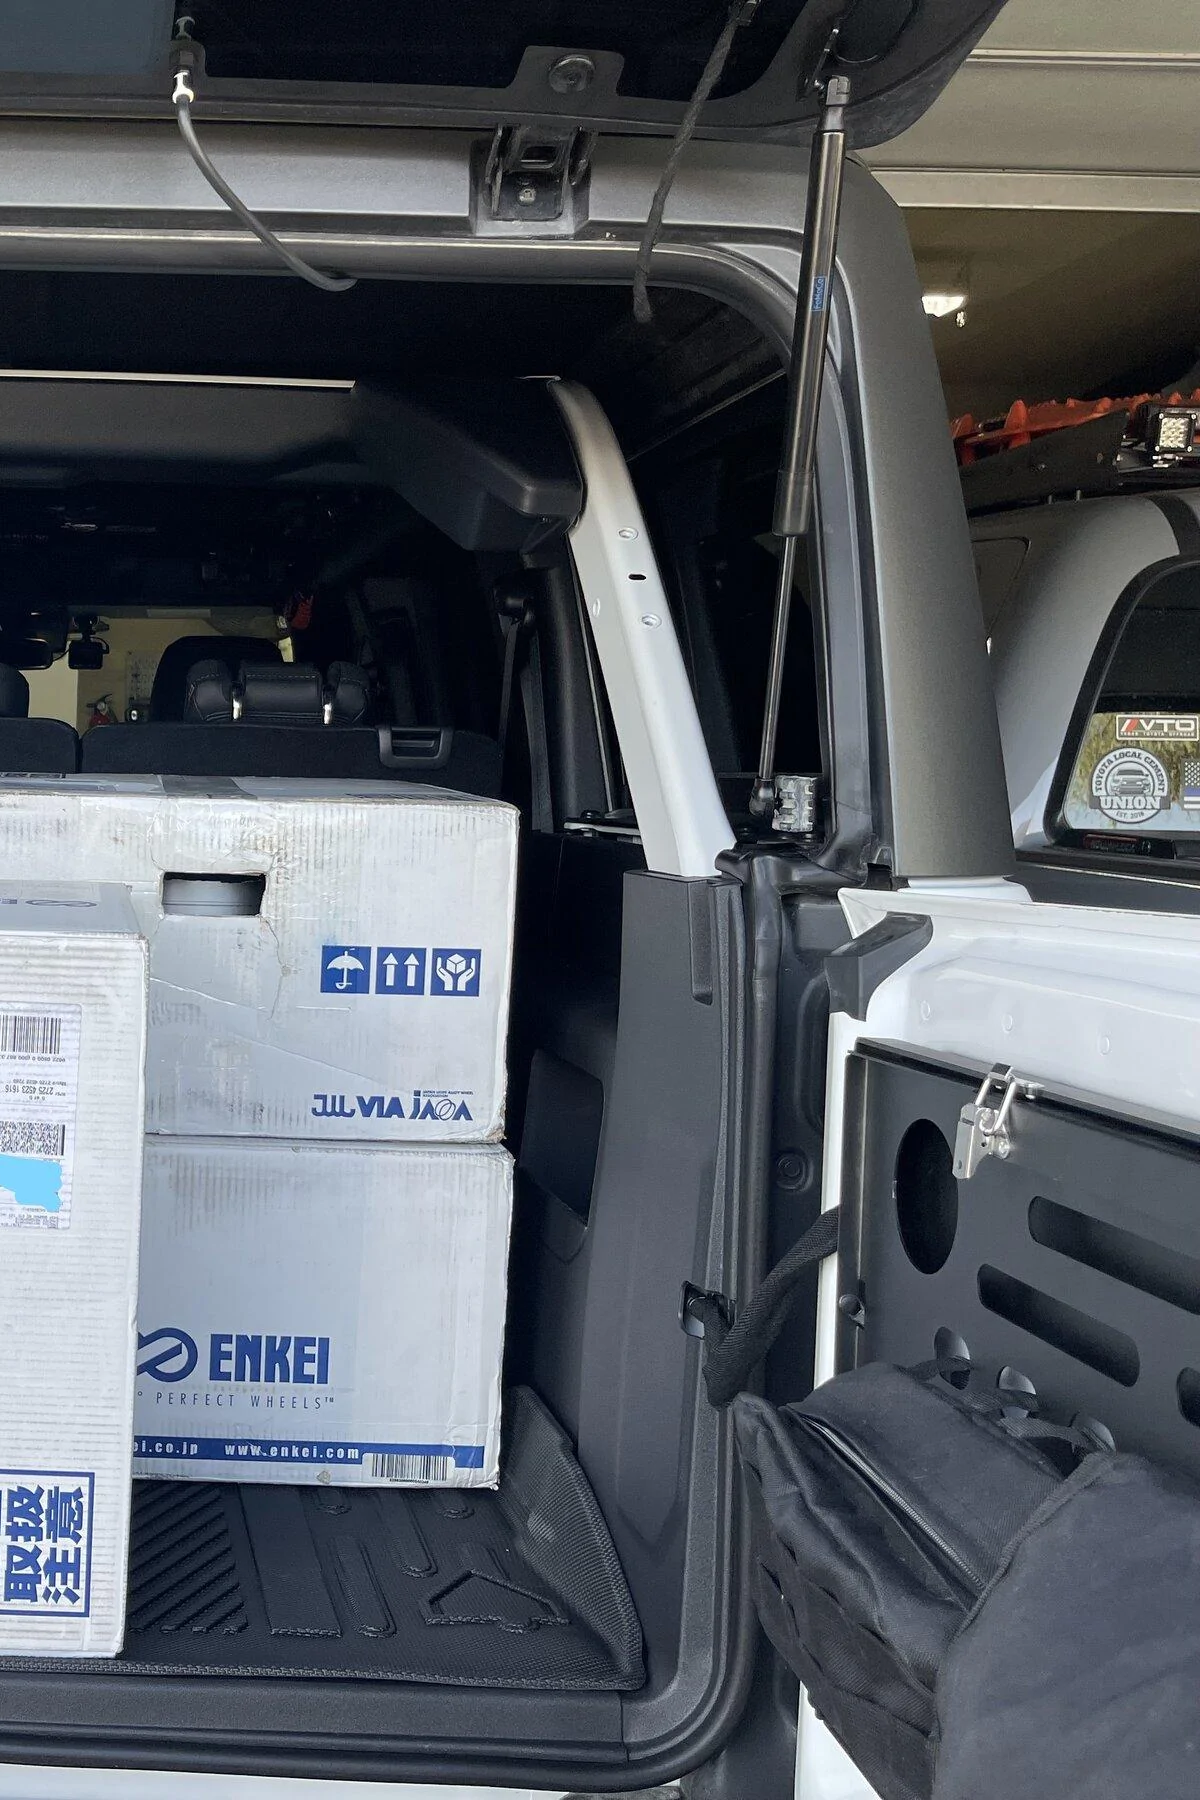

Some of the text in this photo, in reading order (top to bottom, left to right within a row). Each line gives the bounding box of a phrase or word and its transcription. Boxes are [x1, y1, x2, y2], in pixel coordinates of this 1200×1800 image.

[1095, 750, 1165, 793] TOYOTA LOCAL CEMENT
[1100, 796, 1161, 810] UNION
[21, 1085, 37, 1095] 4523
[38, 1086, 54, 1096] 2725
[355, 1095, 405, 1119] VIA
[209, 1333, 330, 1385] ENKEI
[156, 1392, 235, 1407] PERFECT
[224, 1443, 360, 1460] www.enkei.com
[3, 1484, 46, 1603] 取扱
[41, 1485, 84, 1605] 注意
